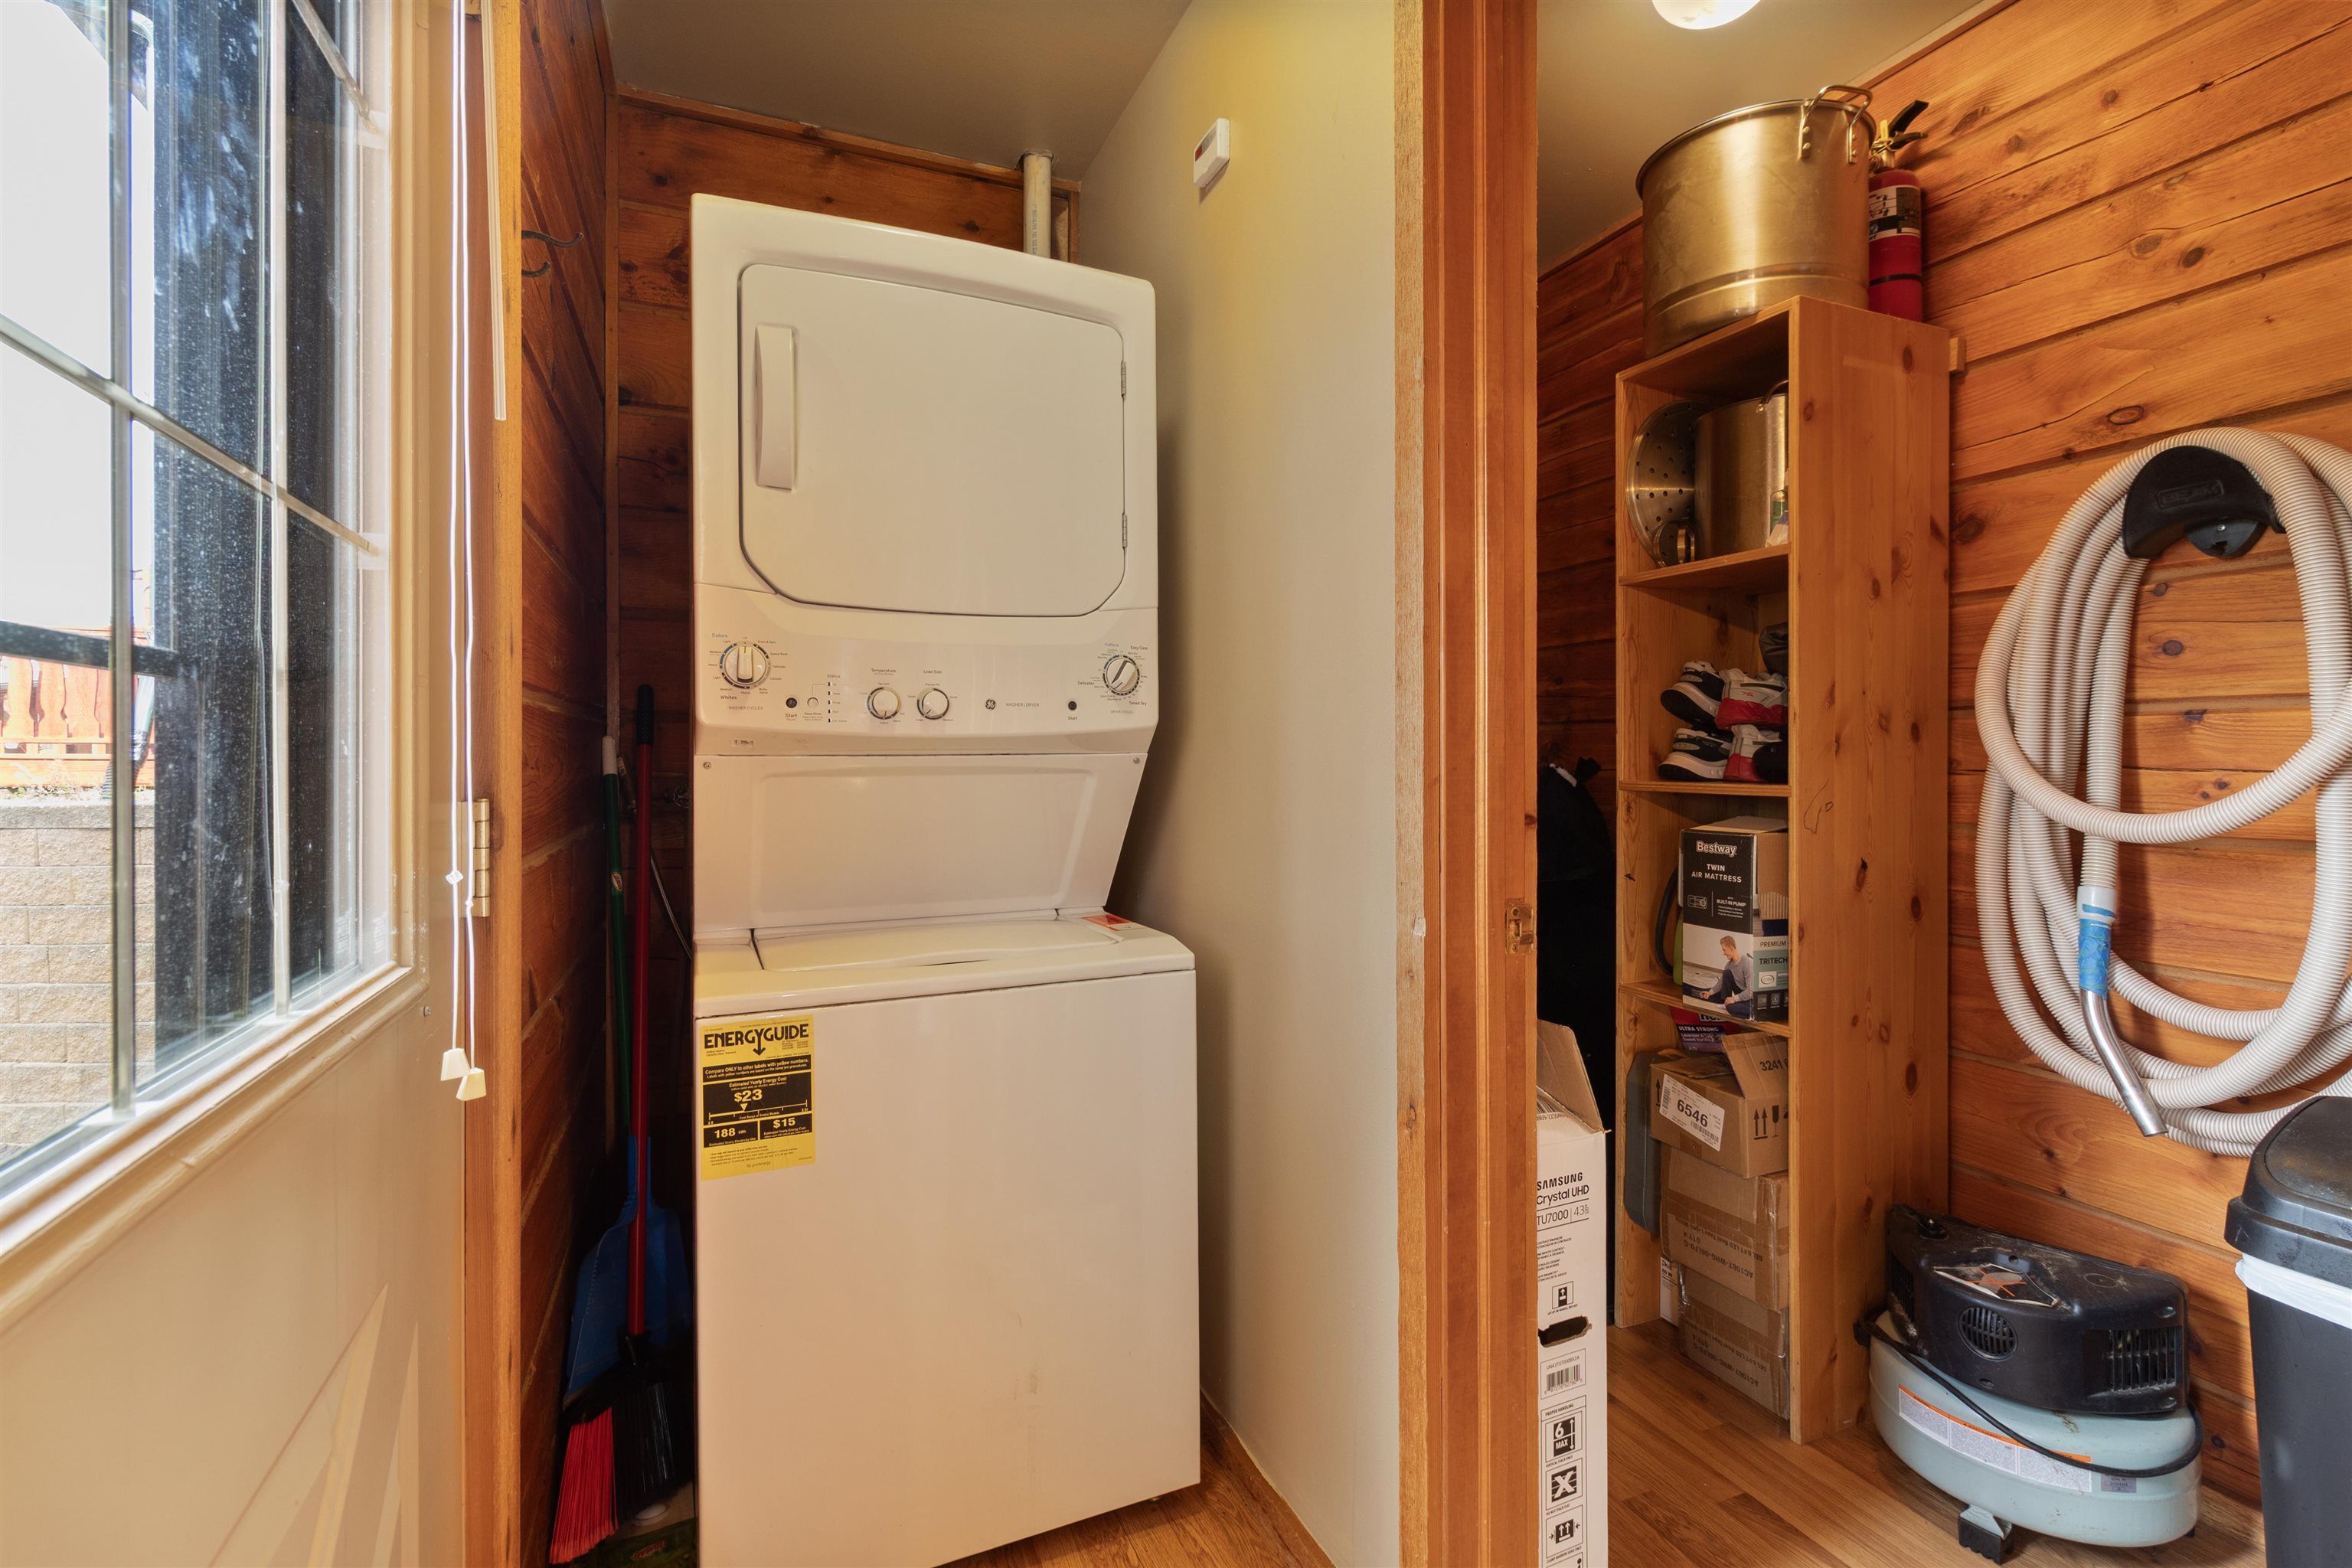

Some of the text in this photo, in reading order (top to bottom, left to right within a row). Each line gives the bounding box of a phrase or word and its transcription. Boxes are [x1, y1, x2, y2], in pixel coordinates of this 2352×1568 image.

[1696, 840, 1737, 858] Bestway
[1704, 873, 1742, 883] MATTRESS
[704, 1024, 808, 1049] ENERGYGUIDE
[1759, 1060, 1783, 1071] 3241
[733, 1088, 763, 1102] $23
[1677, 1099, 1708, 1128] 6546
[773, 1117, 795, 1129] $15
[714, 1128, 736, 1138] 188
[1537, 1172, 1583, 1191] SAMSUNG
[1537, 1184, 1589, 1206] Crystal UHD
[1537, 1205, 1585, 1225] TU7000 43
[1729, 1242, 1740, 1252] LED
[1558, 1403, 1573, 1412] HANDLING
[1554, 1422, 1564, 1439] 6
[1555, 1439, 1568, 1450] MAX
